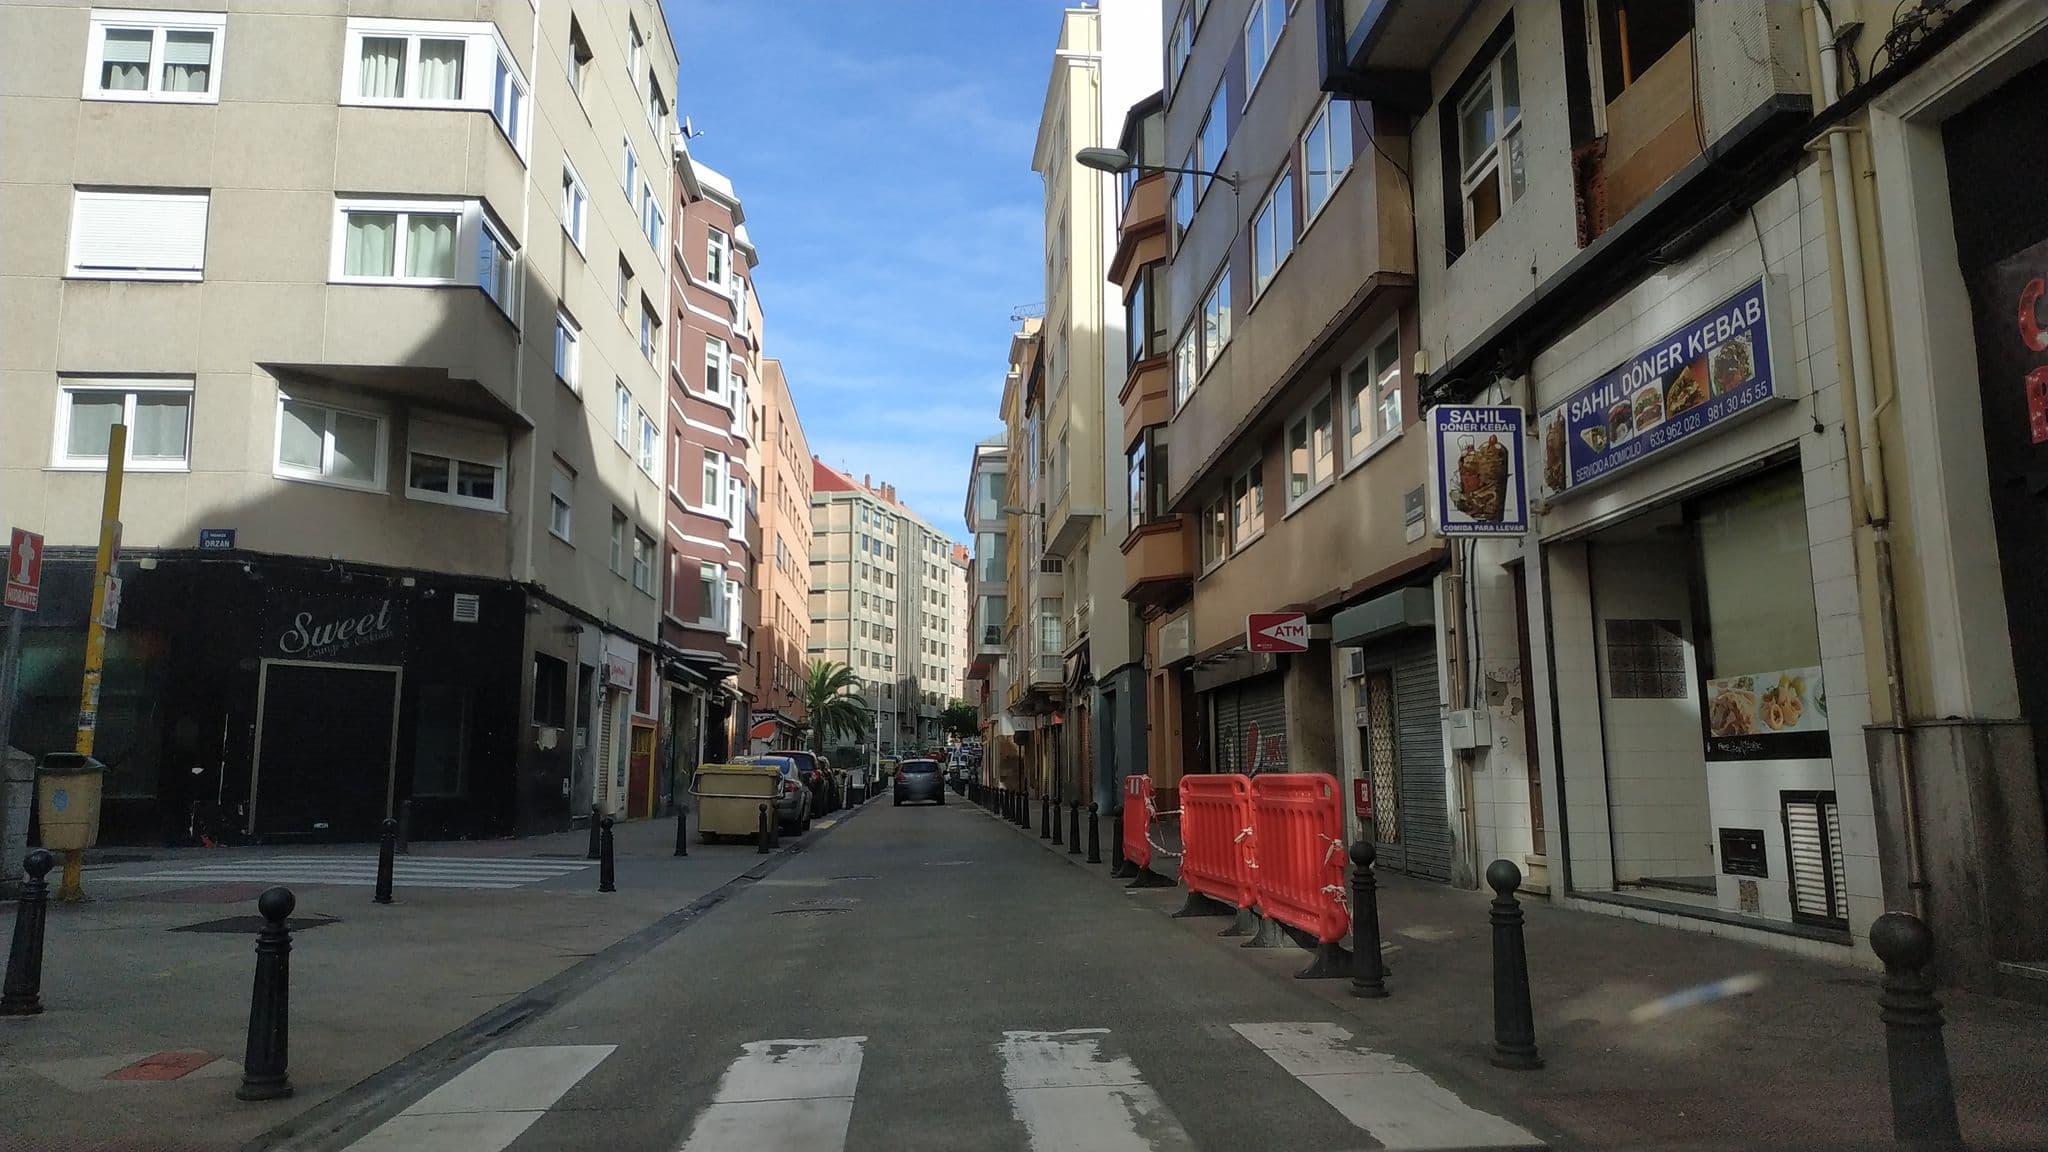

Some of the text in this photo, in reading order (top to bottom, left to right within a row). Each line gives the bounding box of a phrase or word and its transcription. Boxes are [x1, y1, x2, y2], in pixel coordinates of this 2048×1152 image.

[1571, 297, 1761, 423] SAHIL DÖNER KEBAB
[1449, 410, 1506, 423] SAHIL
[1480, 423, 1517, 432] KEBAB
[1576, 459, 1604, 482] SERVICIO
[1609, 441, 1641, 468] DOMICILIO
[1649, 430, 1665, 447] 632
[1666, 421, 1682, 439] 962
[1684, 413, 1701, 432] 028
[1707, 402, 1724, 422] 981
[1726, 395, 1738, 413] 30
[1740, 388, 1753, 407] 45
[1754, 380, 1768, 399] 55
[1443, 524, 1473, 532] COMIDA
[280, 599, 390, 653] Sweet
[1274, 625, 1304, 637] ATM
